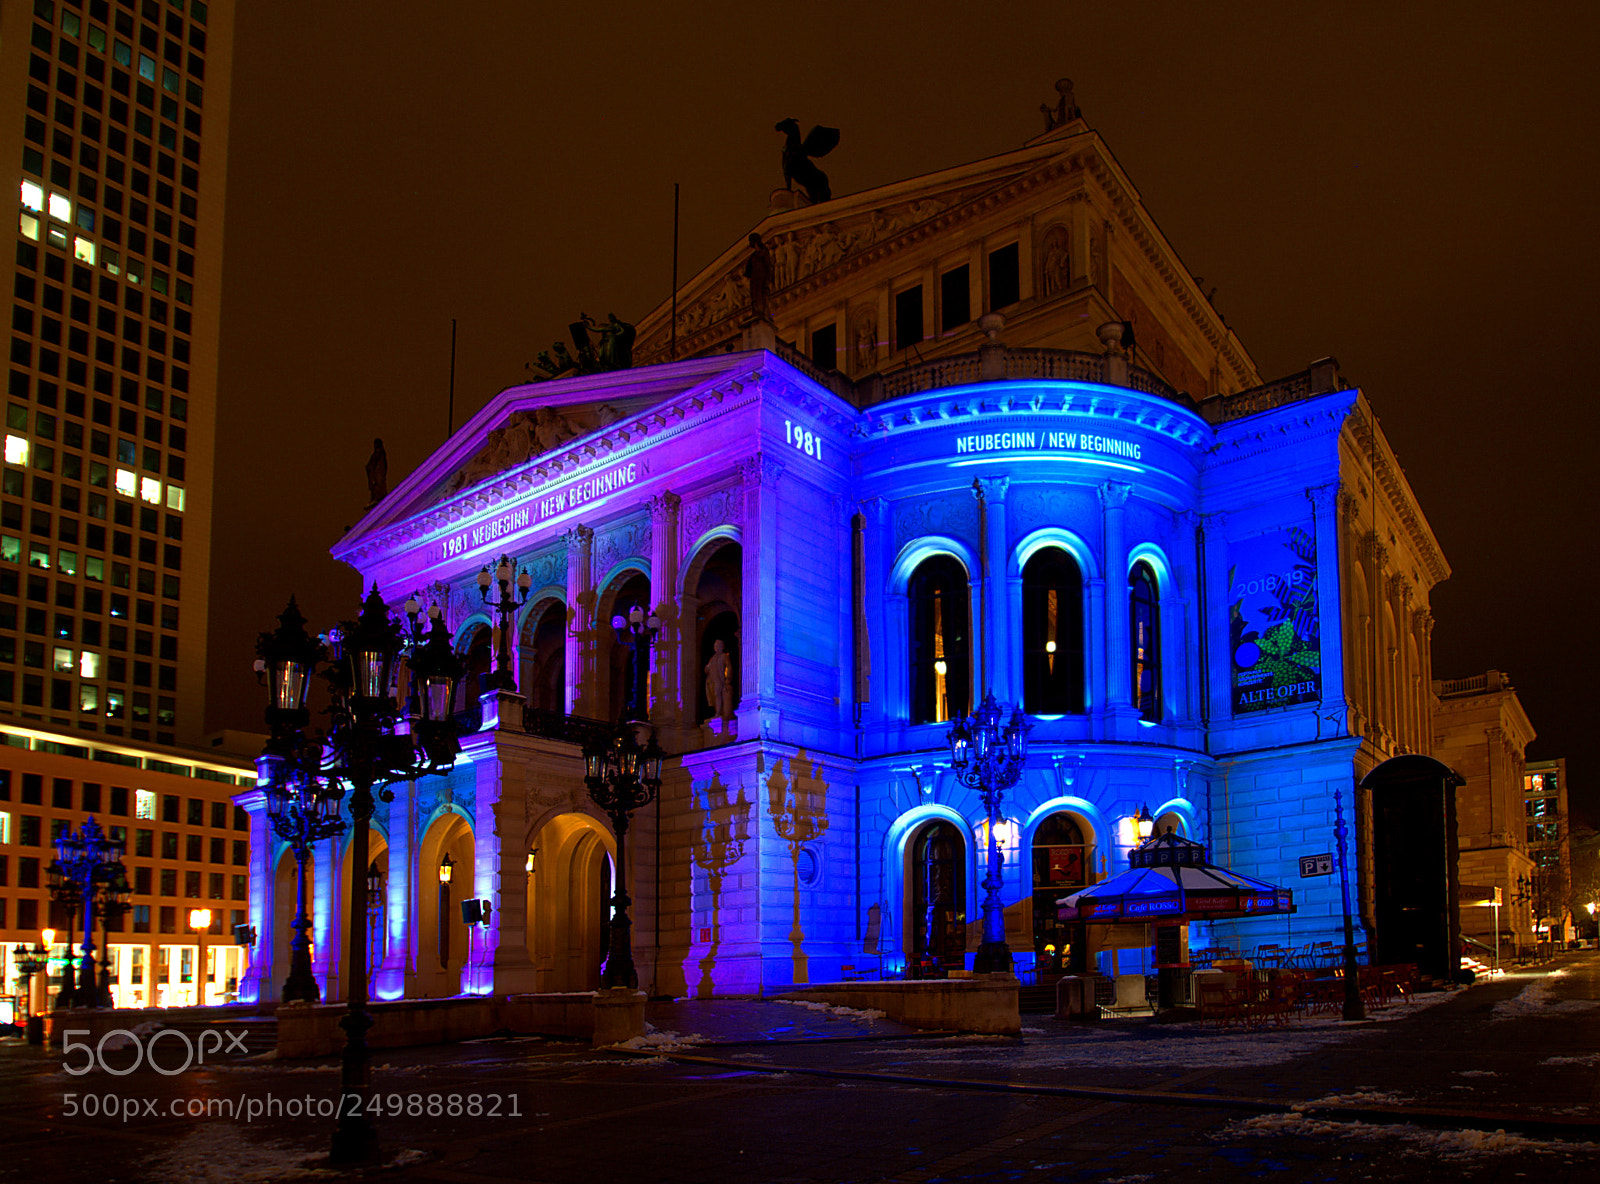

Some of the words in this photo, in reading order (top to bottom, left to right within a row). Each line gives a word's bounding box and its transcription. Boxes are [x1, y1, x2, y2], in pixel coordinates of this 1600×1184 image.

[784, 419, 822, 461] 1981
[956, 432, 1036, 453] NEUBEGINN
[1049, 433, 1077, 449] NEW
[1080, 434, 1141, 460] BEGINNING
[441, 535, 468, 559] 1981
[472, 508, 530, 547] NEUBEGINN
[541, 491, 567, 519] NEW
[569, 462, 637, 508] BEGINNING
[1238, 687, 1275, 705] ALTE
[1277, 680, 1316, 698] OPER
[1160, 853, 1169, 863] P
[1177, 853, 1185, 862] P
[1192, 853, 1199, 862] P
[1305, 862, 1314, 874] P
[1149, 901, 1179, 911] ROSSO
